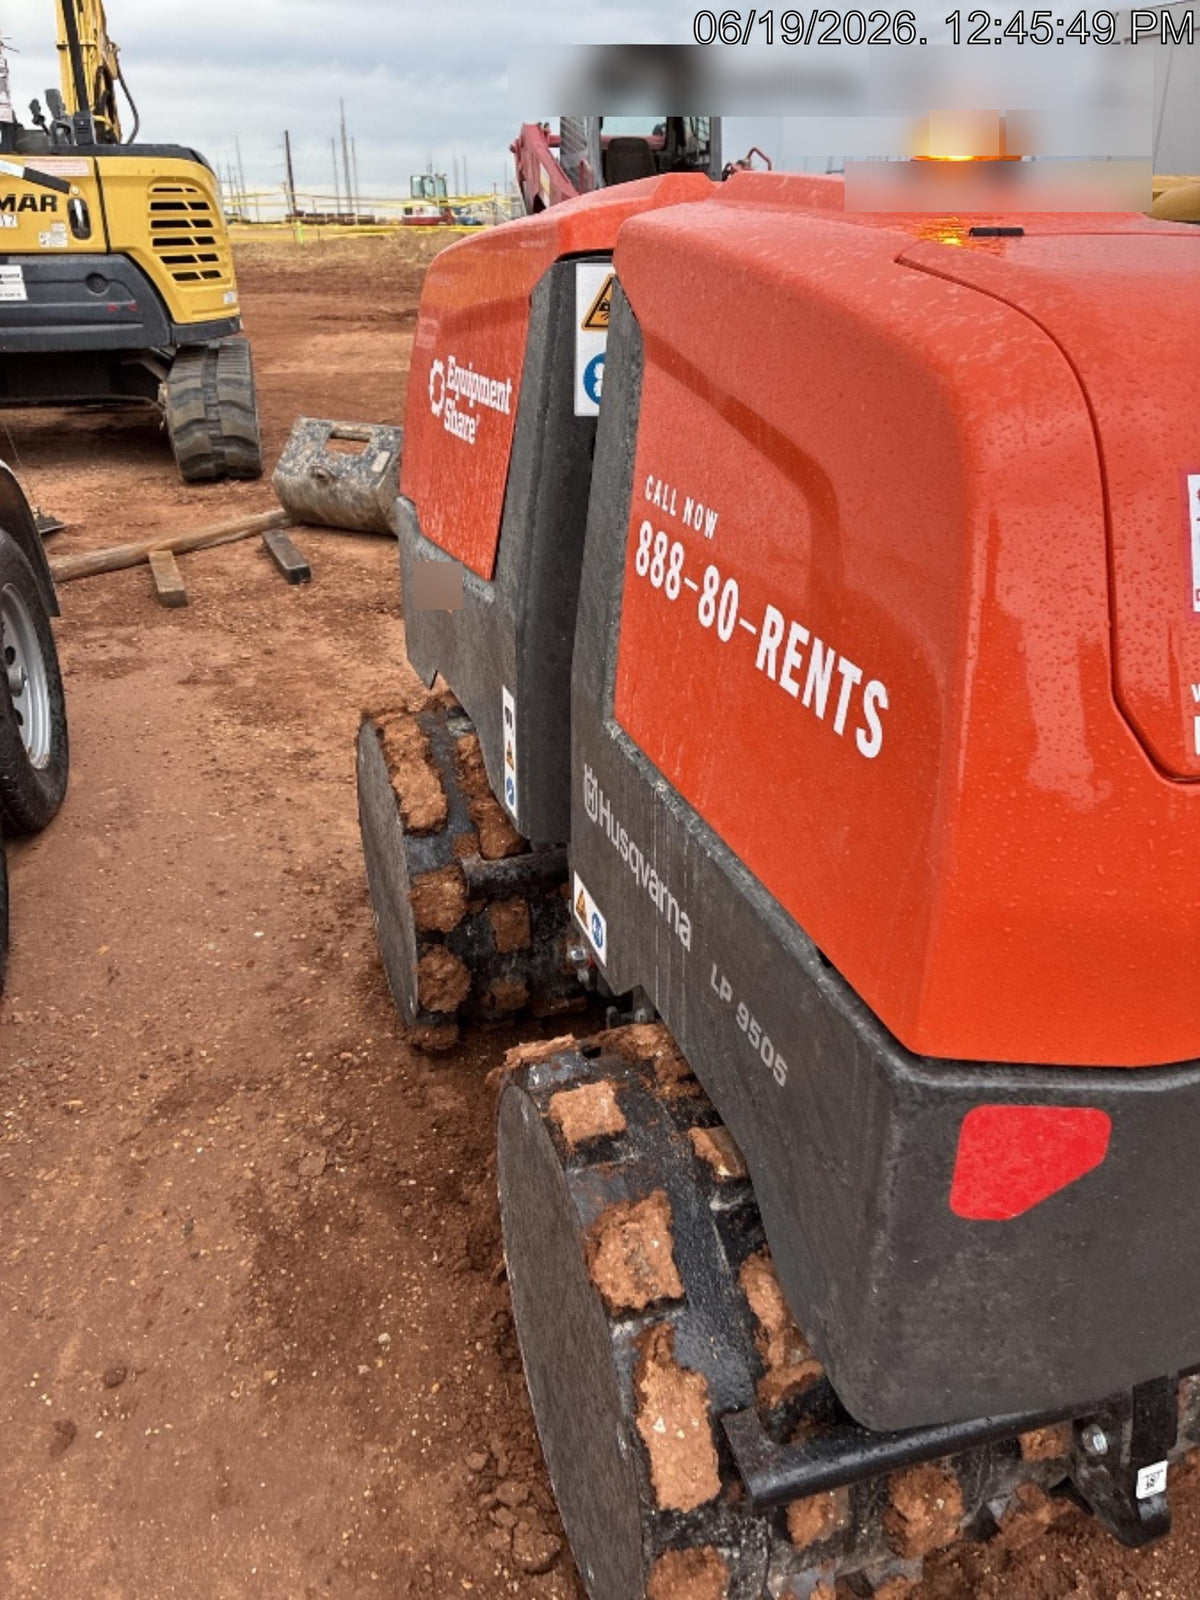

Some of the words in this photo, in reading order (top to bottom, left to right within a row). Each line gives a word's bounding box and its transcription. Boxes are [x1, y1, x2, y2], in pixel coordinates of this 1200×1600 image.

[443, 397, 476, 446] Share
[446, 354, 513, 416] Equipment
[644, 474, 678, 517] CALL
[682, 496, 719, 539] NOW
[635, 520, 890, 759] 888-80-RENTS
[599, 789, 692, 952] Husqvarna
[710, 962, 732, 1002] LP
[735, 1002, 788, 1088] 9505
